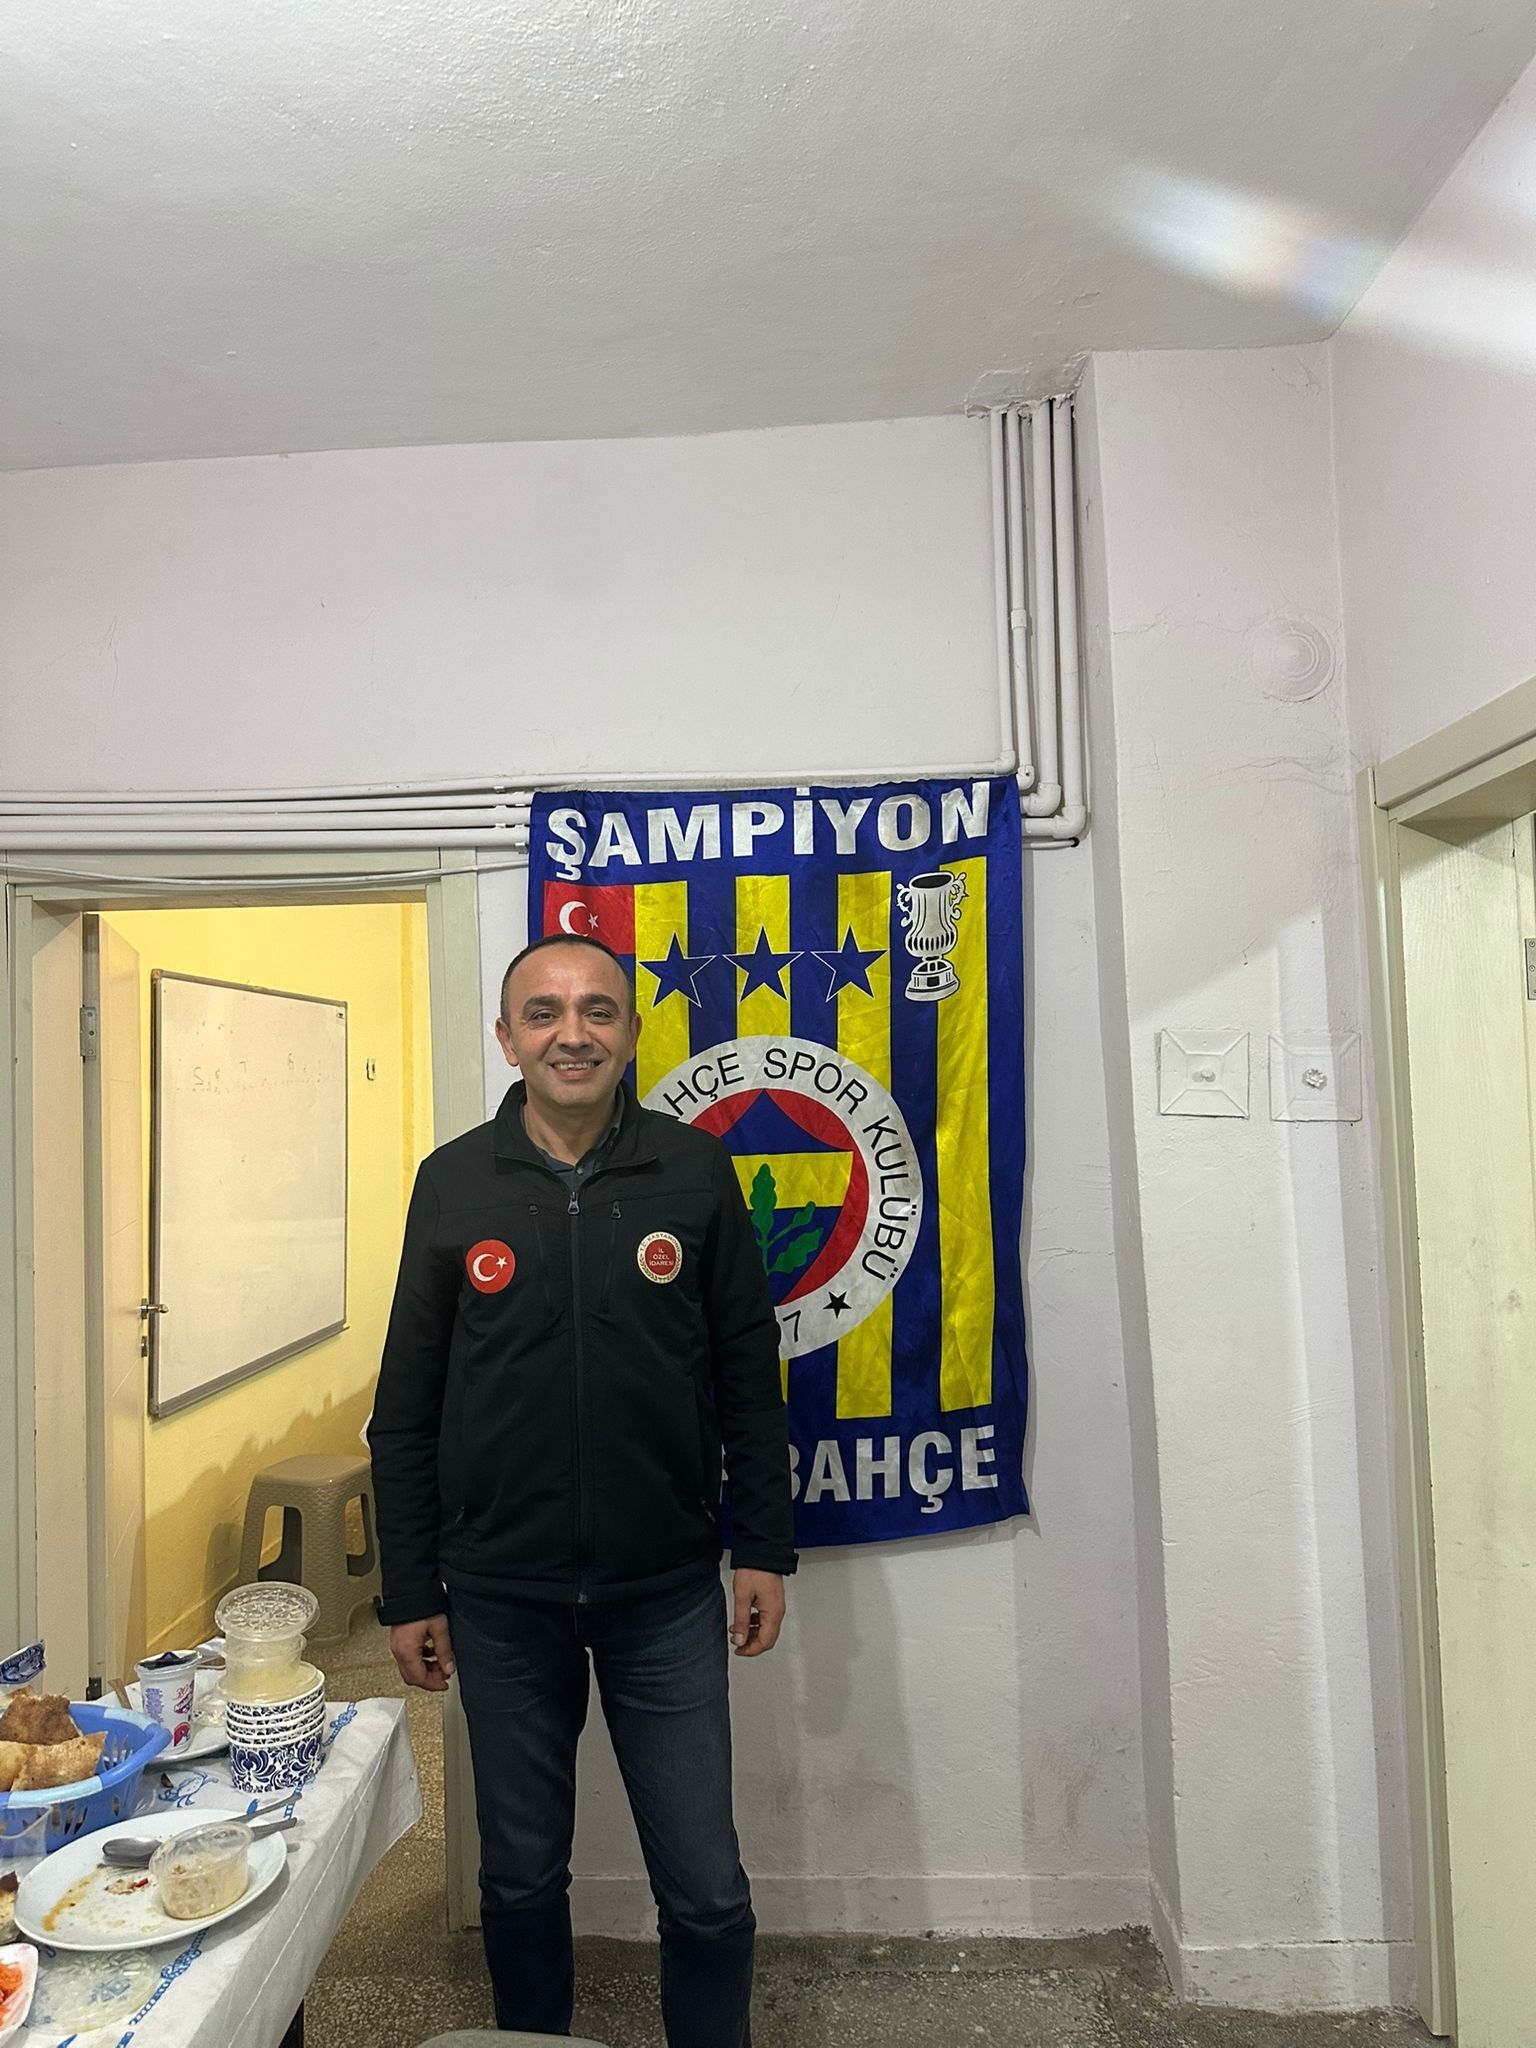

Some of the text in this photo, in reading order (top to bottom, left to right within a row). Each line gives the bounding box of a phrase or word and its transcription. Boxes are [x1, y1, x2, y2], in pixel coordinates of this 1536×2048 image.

[545, 781, 991, 881] ŞAMPİYON
[763, 1047, 869, 1116] SPOR
[862, 1114, 918, 1282] KULÜBÜ
[782, 1309, 802, 1343] 7
